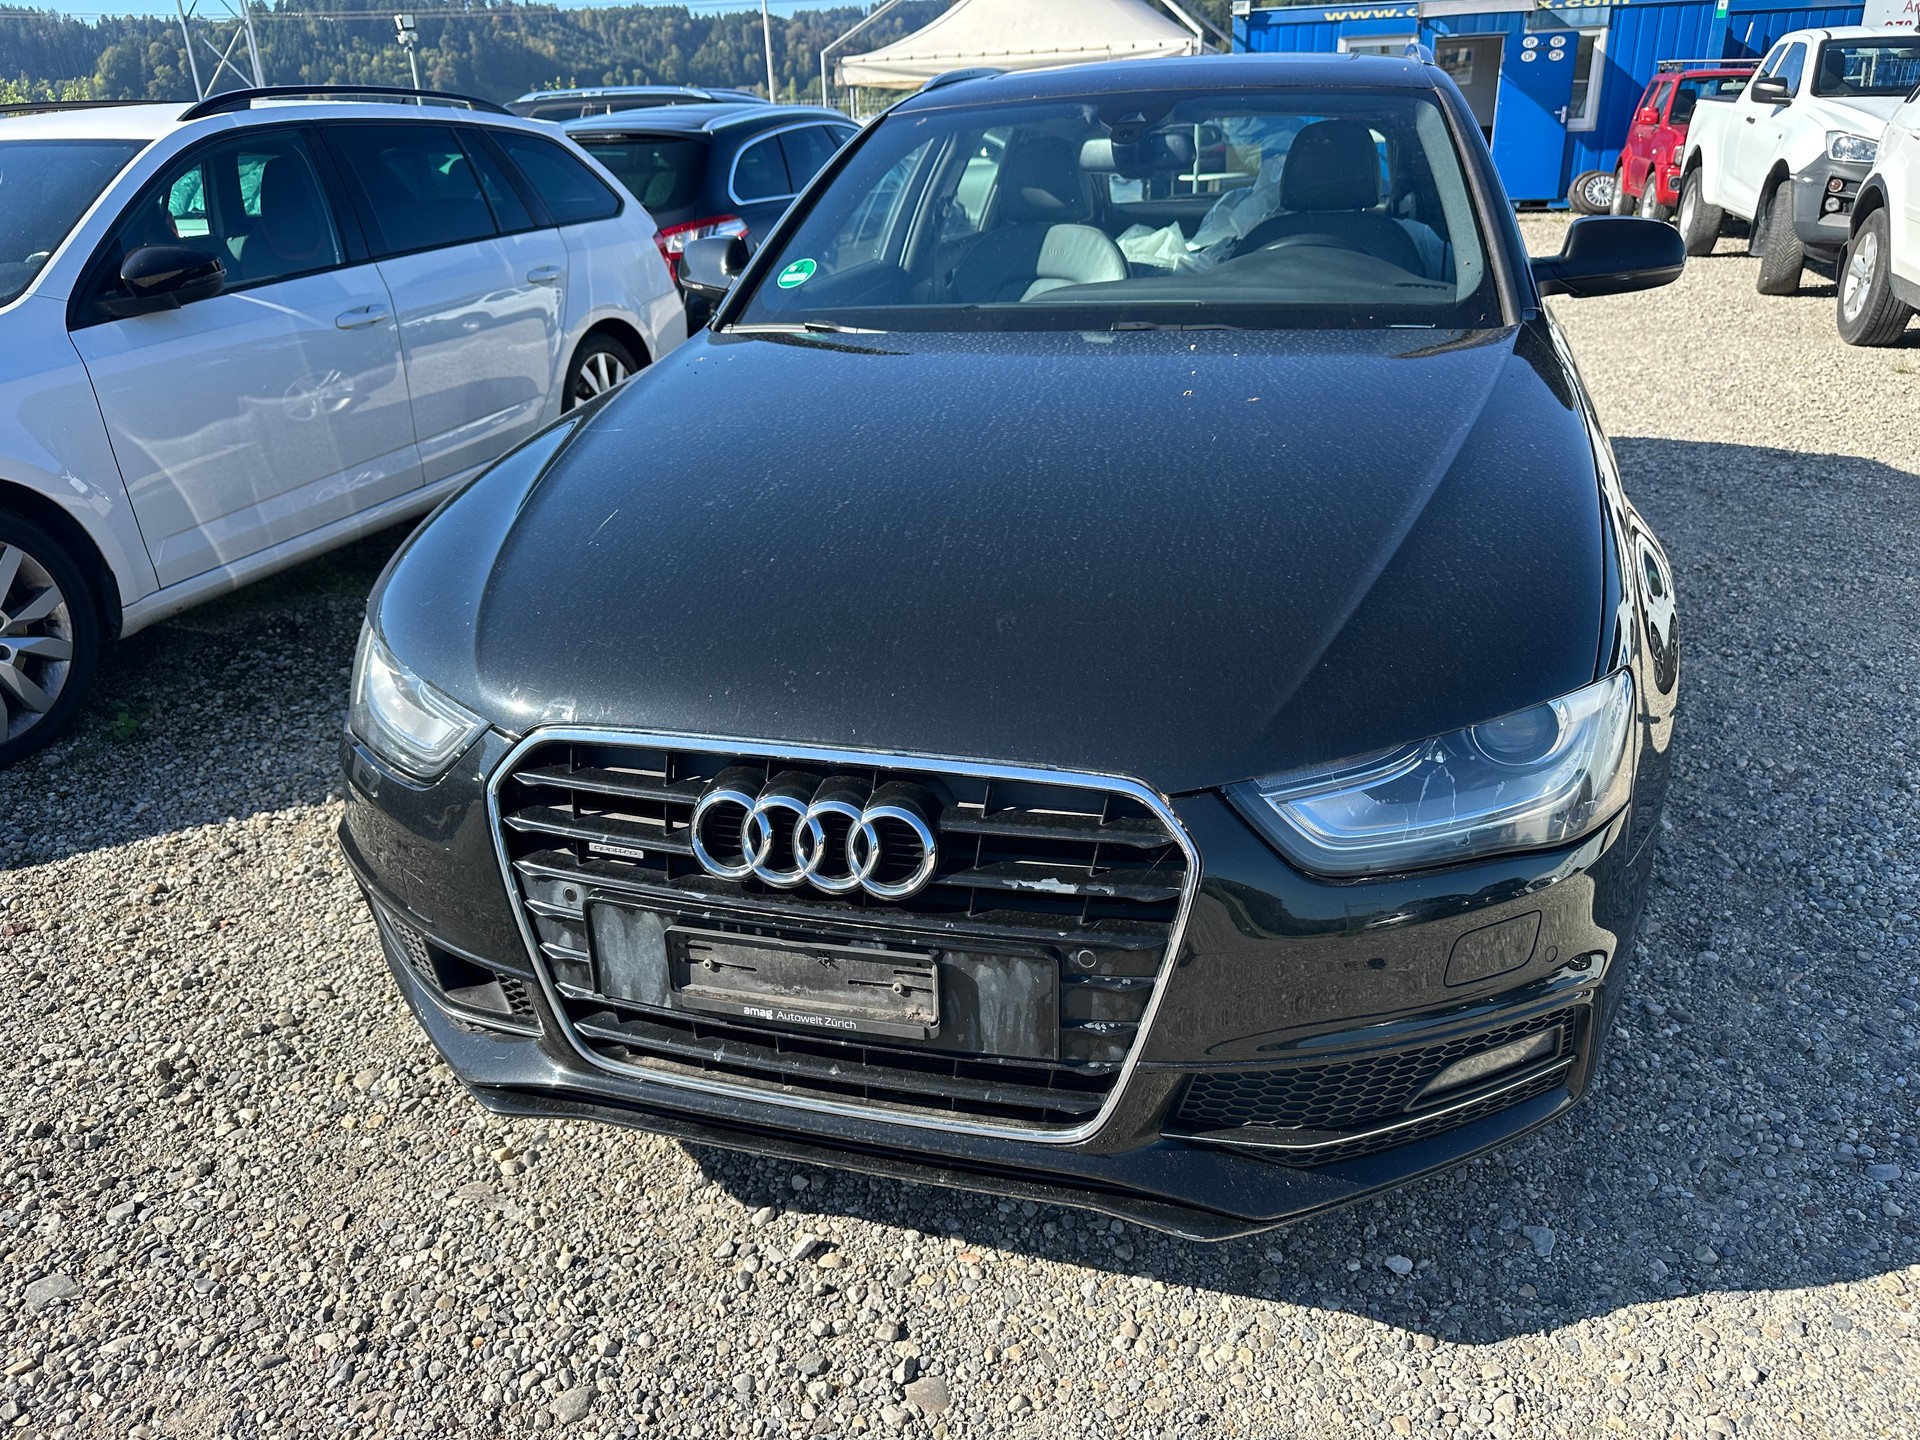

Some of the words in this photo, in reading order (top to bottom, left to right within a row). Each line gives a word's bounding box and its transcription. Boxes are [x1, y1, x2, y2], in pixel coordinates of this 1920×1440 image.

[743, 1006, 773, 1020] amag
[776, 1011, 823, 1026] Autowelt
[824, 1016, 857, 1030] Zürich
